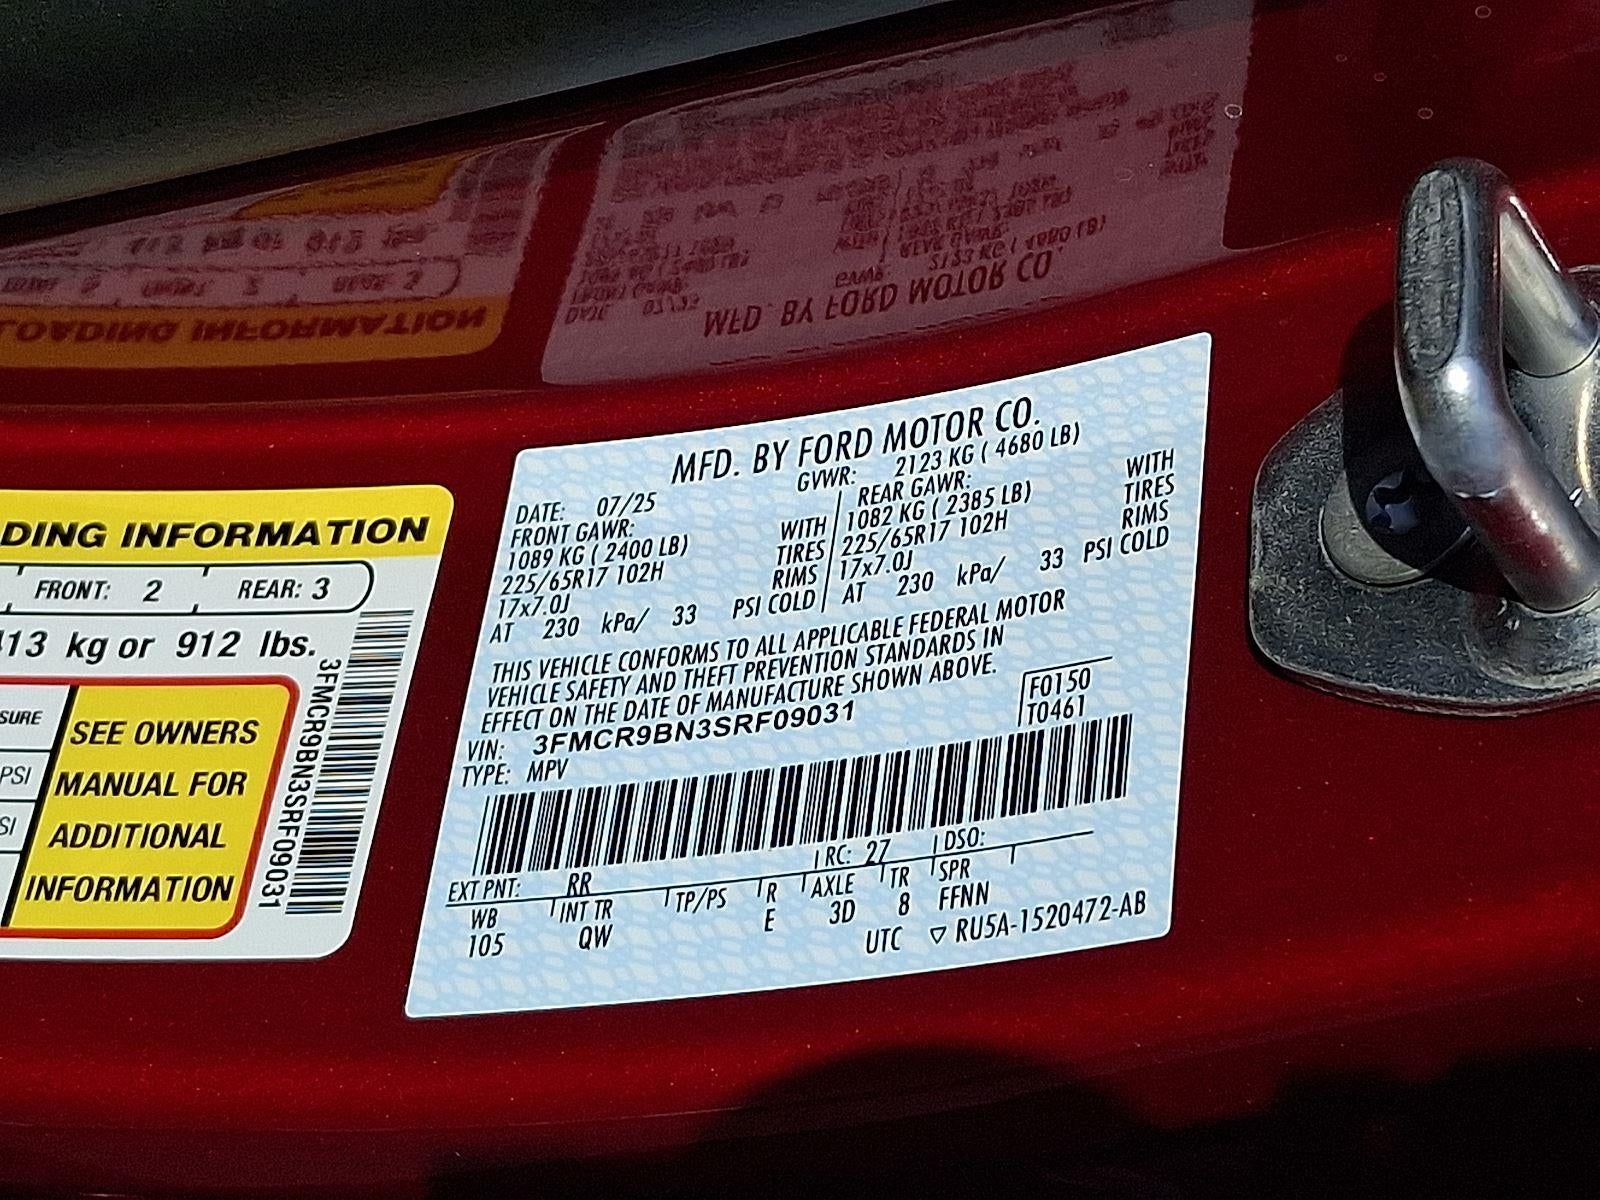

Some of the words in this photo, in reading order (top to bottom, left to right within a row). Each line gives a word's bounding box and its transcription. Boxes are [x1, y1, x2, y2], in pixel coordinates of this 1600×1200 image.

[671, 449, 740, 484] MFD.
[753, 439, 789, 474] BY
[798, 427, 873, 468] FORD
[882, 406, 984, 455] MOTOR
[995, 397, 1041, 432] CO.
[797, 467, 857, 492] GVWR:
[895, 451, 942, 477] 2123
[949, 443, 975, 467] KG
[996, 430, 1044, 458] 4680
[1051, 422, 1080, 448] LB)
[1126, 448, 1174, 478] WITH
[858, 481, 904, 507] REAR
[910, 471, 972, 497] GAWR:
[1124, 473, 1176, 503] TIRES
[515, 502, 566, 525] DATE:
[596, 491, 657, 518] 07/25
[848, 506, 892, 531] 1082
[899, 501, 925, 524] KG
[945, 488, 995, 516] 2385
[1001, 481, 1031, 505] LB)
[1121, 501, 1169, 529] RIMS
[120, 516, 430, 550] INFORMATION
[510, 523, 570, 548] FRONT
[575, 519, 636, 542] GAWR:
[781, 516, 827, 541] WITH
[842, 519, 951, 557] 225/65R17
[959, 509, 1009, 537] 102H
[508, 549, 552, 570] 1089
[559, 545, 585, 567] KG
[605, 536, 653, 562] 2400
[658, 533, 688, 556] LB)
[776, 539, 826, 566] TIRES
[839, 550, 914, 580] 17x7.0J
[841, 581, 866, 605] AT
[896, 571, 934, 597] 230
[957, 556, 1006, 587] kPa/
[1039, 548, 1064, 572] 33
[1083, 537, 1113, 563] PSI
[1120, 525, 1170, 555] COLD
[34, 579, 111, 600] FRONT:
[143, 579, 163, 602] 2
[238, 578, 302, 600] REAR:
[312, 577, 331, 600] 3
[501, 566, 609, 596] 225/65R17
[617, 561, 664, 586] 102H
[772, 564, 819, 590] RIMS
[489, 622, 514, 643] AT
[542, 616, 580, 639] 230
[601, 608, 651, 634] kPa/
[672, 604, 697, 626] 33
[732, 596, 760, 620] PSI
[767, 589, 816, 615] COLD
[498, 594, 570, 619] 17x7.0J
[0, 629, 48, 658] 13
[65, 631, 109, 665] kg
[118, 636, 155, 659] or
[176, 630, 241, 658] 912
[259, 629, 316, 657] lbs.
[492, 659, 532, 683] THIS
[539, 653, 612, 679] VEHICLE
[618, 641, 719, 672] CONFORMS
[726, 638, 748, 660] TO
[756, 632, 787, 656] ALL
[793, 616, 904, 652] APPLICABLE
[908, 602, 990, 636] FEDERAL
[996, 588, 1066, 622] MOTOR
[487, 682, 561, 707] VEHICLE
[566, 675, 631, 702] SAFETY
[636, 671, 676, 694] AND
[684, 663, 737, 689] THEFT
[743, 649, 857, 684] PREVENTION
[864, 631, 977, 667] STANDARDS
[982, 625, 1005, 647] IN
[481, 708, 544, 734] EFFECT
[550, 704, 578, 727] ON
[584, 700, 618, 725] THE
[623, 696, 670, 722] DATE
[676, 693, 701, 716] OF
[705, 674, 845, 713] MANUFACTURE
[851, 664, 922, 695] SHOWN
[929, 652, 997, 683] ABOVE.
[1027, 694, 1086, 726] T0461
[69, 720, 127, 746] SEE
[134, 719, 260, 746] OWNERS
[468, 739, 506, 761] VIN:
[533, 700, 855, 756] 3FMCR9BN3SRF09031
[0, 766, 32, 785] PSI
[54, 772, 180, 797] MANUAL
[188, 771, 248, 797] FOR
[259, 658, 342, 908] 3FMCR9BN3SRF09031
[462, 764, 512, 787] TYPE:
[526, 758, 569, 783] MPV
[48, 822, 226, 849] ADDITIONAL
[944, 826, 985, 850] DSO:
[826, 845, 852, 866] RC:
[865, 839, 891, 865] 27
[891, 866, 910, 889] TR
[939, 859, 970, 881] SPR
[25, 875, 235, 902] INFORMATION
[449, 880, 480, 902] EXT
[483, 877, 521, 900] PNT:
[566, 872, 592, 897] RR
[766, 881, 777, 903] R
[810, 873, 855, 899] AXLE
[938, 881, 990, 910] FFNN
[559, 901, 586, 923] INT
[594, 899, 613, 921] TR
[676, 887, 727, 914] TP/PS
[829, 899, 856, 925] 3D
[898, 892, 910, 916] 8
[470, 907, 498, 930] WB
[764, 908, 776, 932] E
[865, 927, 903, 954] UTC
[955, 890, 1146, 942] RU5A-1520472-AB
[469, 932, 505, 958] 105
[578, 924, 614, 950] QW
